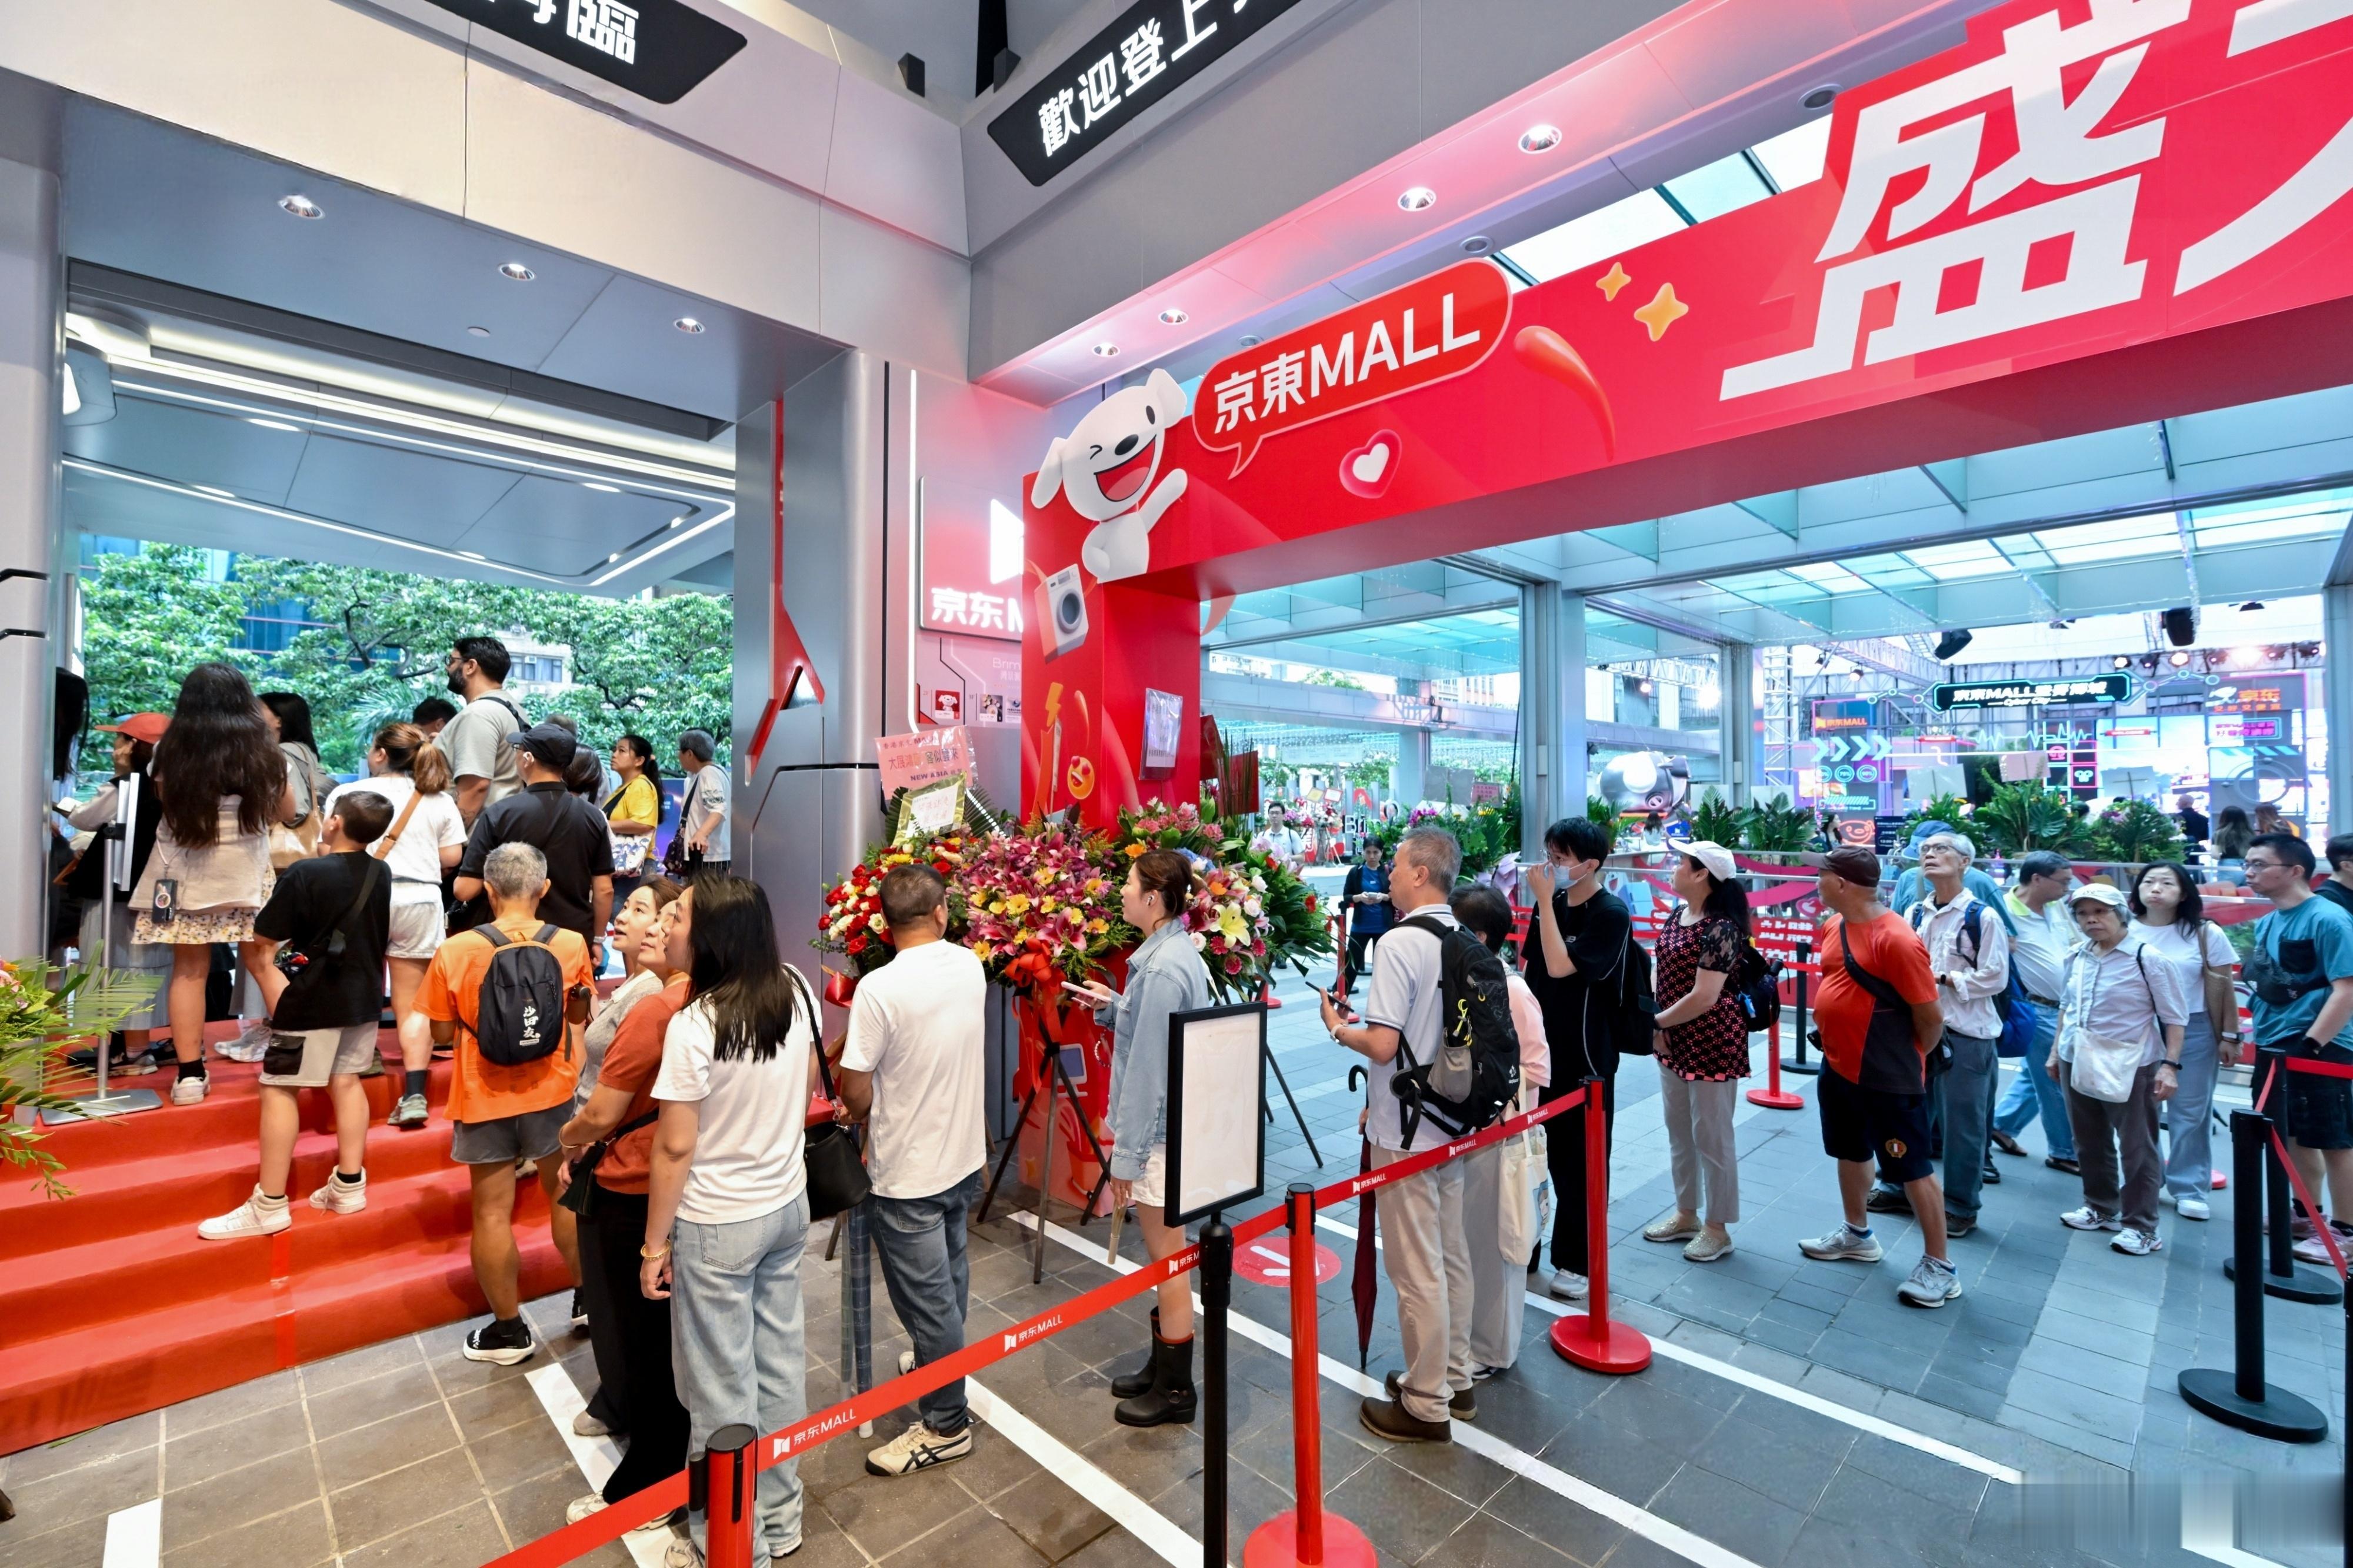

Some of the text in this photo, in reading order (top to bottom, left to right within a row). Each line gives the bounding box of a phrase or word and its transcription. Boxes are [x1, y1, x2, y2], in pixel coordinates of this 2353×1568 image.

[488, 0, 639, 65] 臨
[1038, 0, 1249, 157] 歡迎登上
[1214, 293, 1480, 434] 京東MALL
[931, 770, 949, 779] ASIA
[1018, 1315, 1063, 1343] 京东MALL
[794, 1409, 856, 1446] 京东MALL
